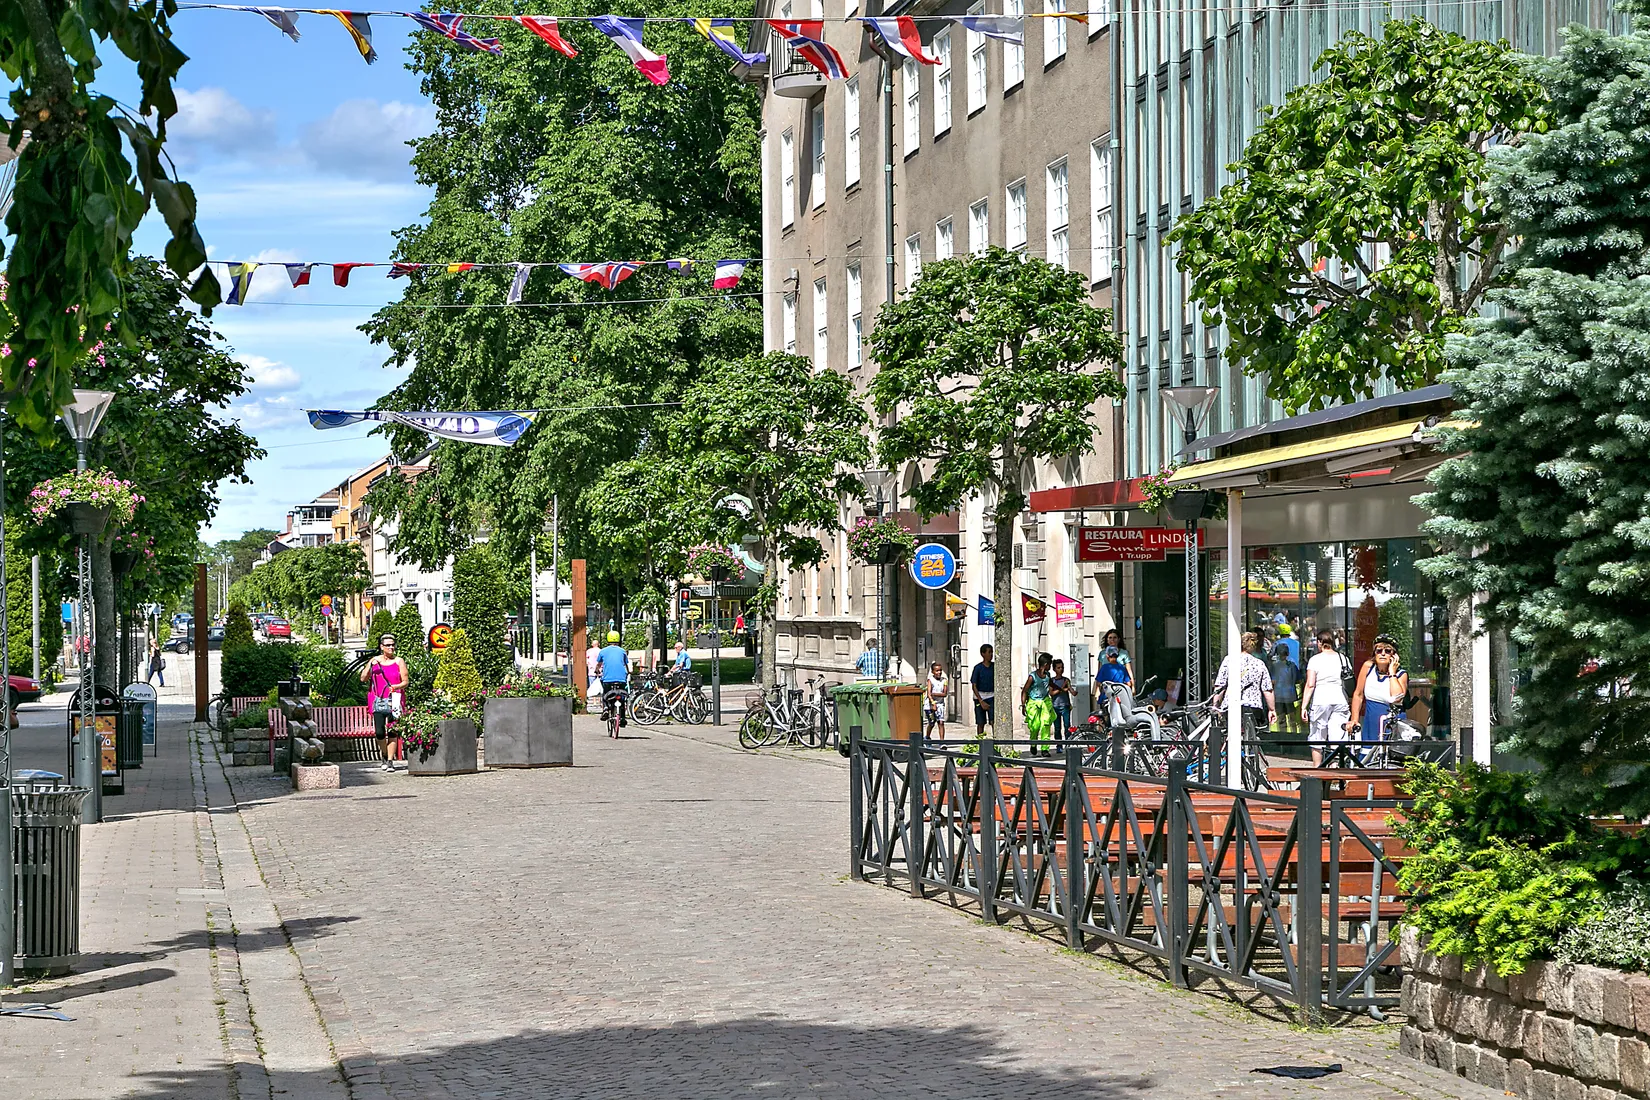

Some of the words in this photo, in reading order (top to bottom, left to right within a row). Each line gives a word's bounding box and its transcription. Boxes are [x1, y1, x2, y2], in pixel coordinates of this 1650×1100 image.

[1085, 530, 1144, 540] RESTAURA
[920, 559, 945, 571] 24
[920, 569, 946, 577] SEVEN
